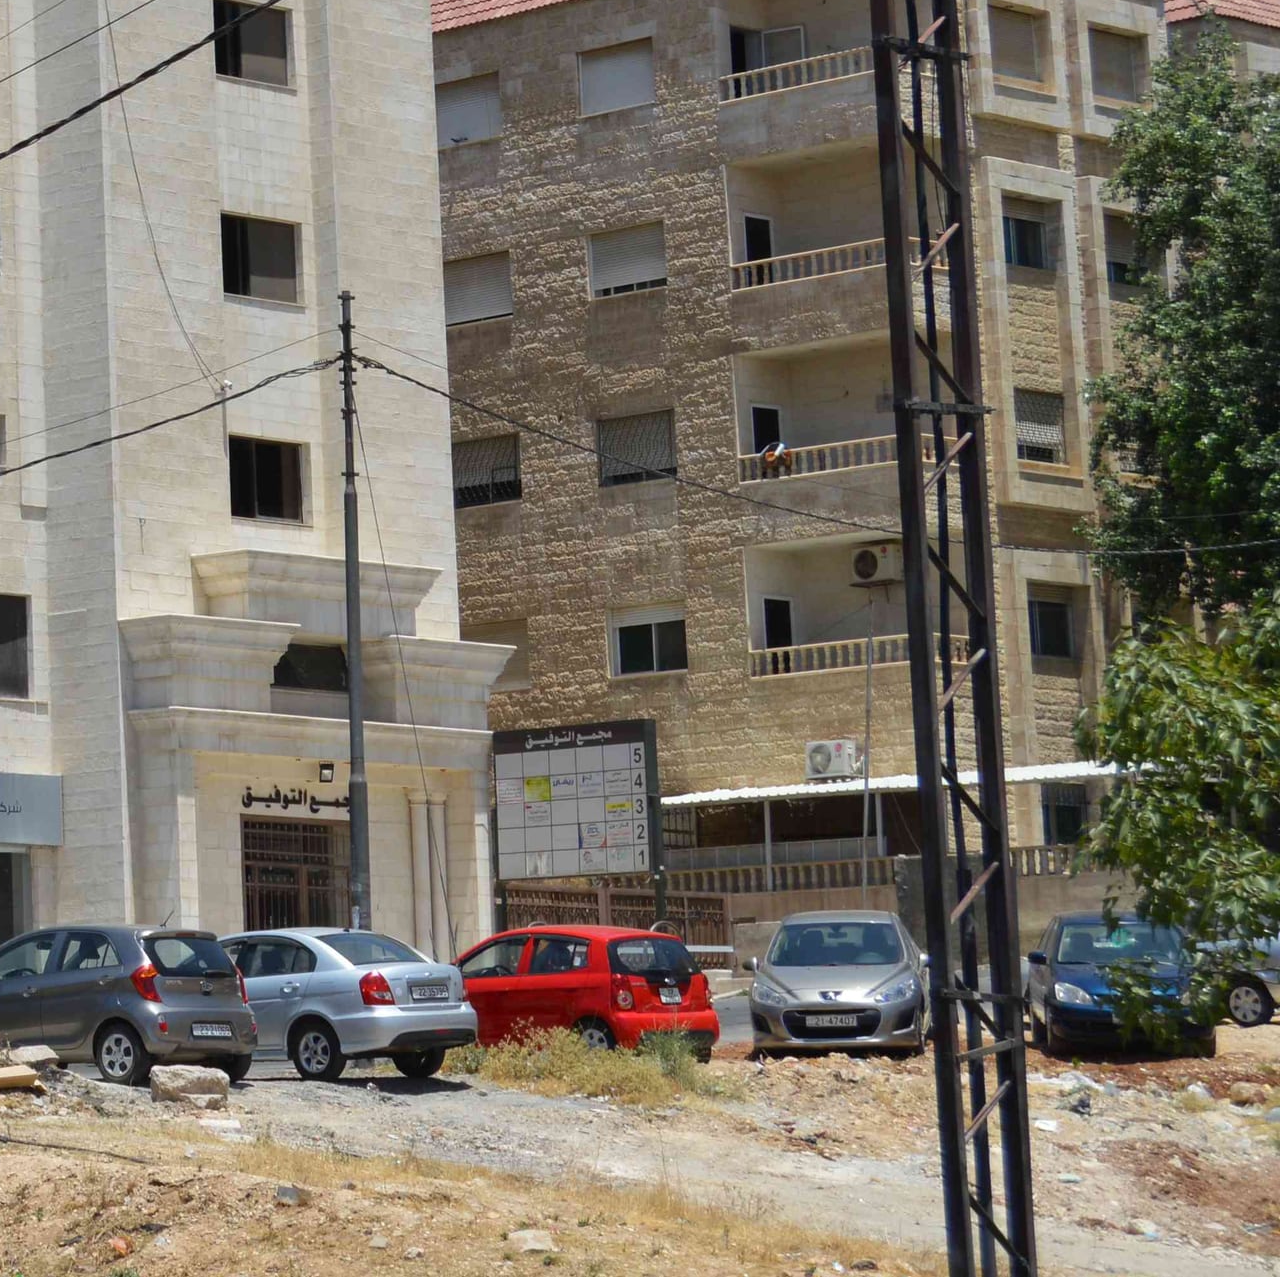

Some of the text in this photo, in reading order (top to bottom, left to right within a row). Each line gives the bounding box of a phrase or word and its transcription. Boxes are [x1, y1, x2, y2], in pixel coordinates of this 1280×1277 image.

[524, 729, 613, 749] مجمع التوفيق
[633, 748, 642, 763] 5
[634, 773, 643, 789] 4
[241, 784, 308, 809] التوفيق
[635, 799, 644, 814] 3
[636, 824, 646, 840] 2
[638, 850, 645, 865] 1
